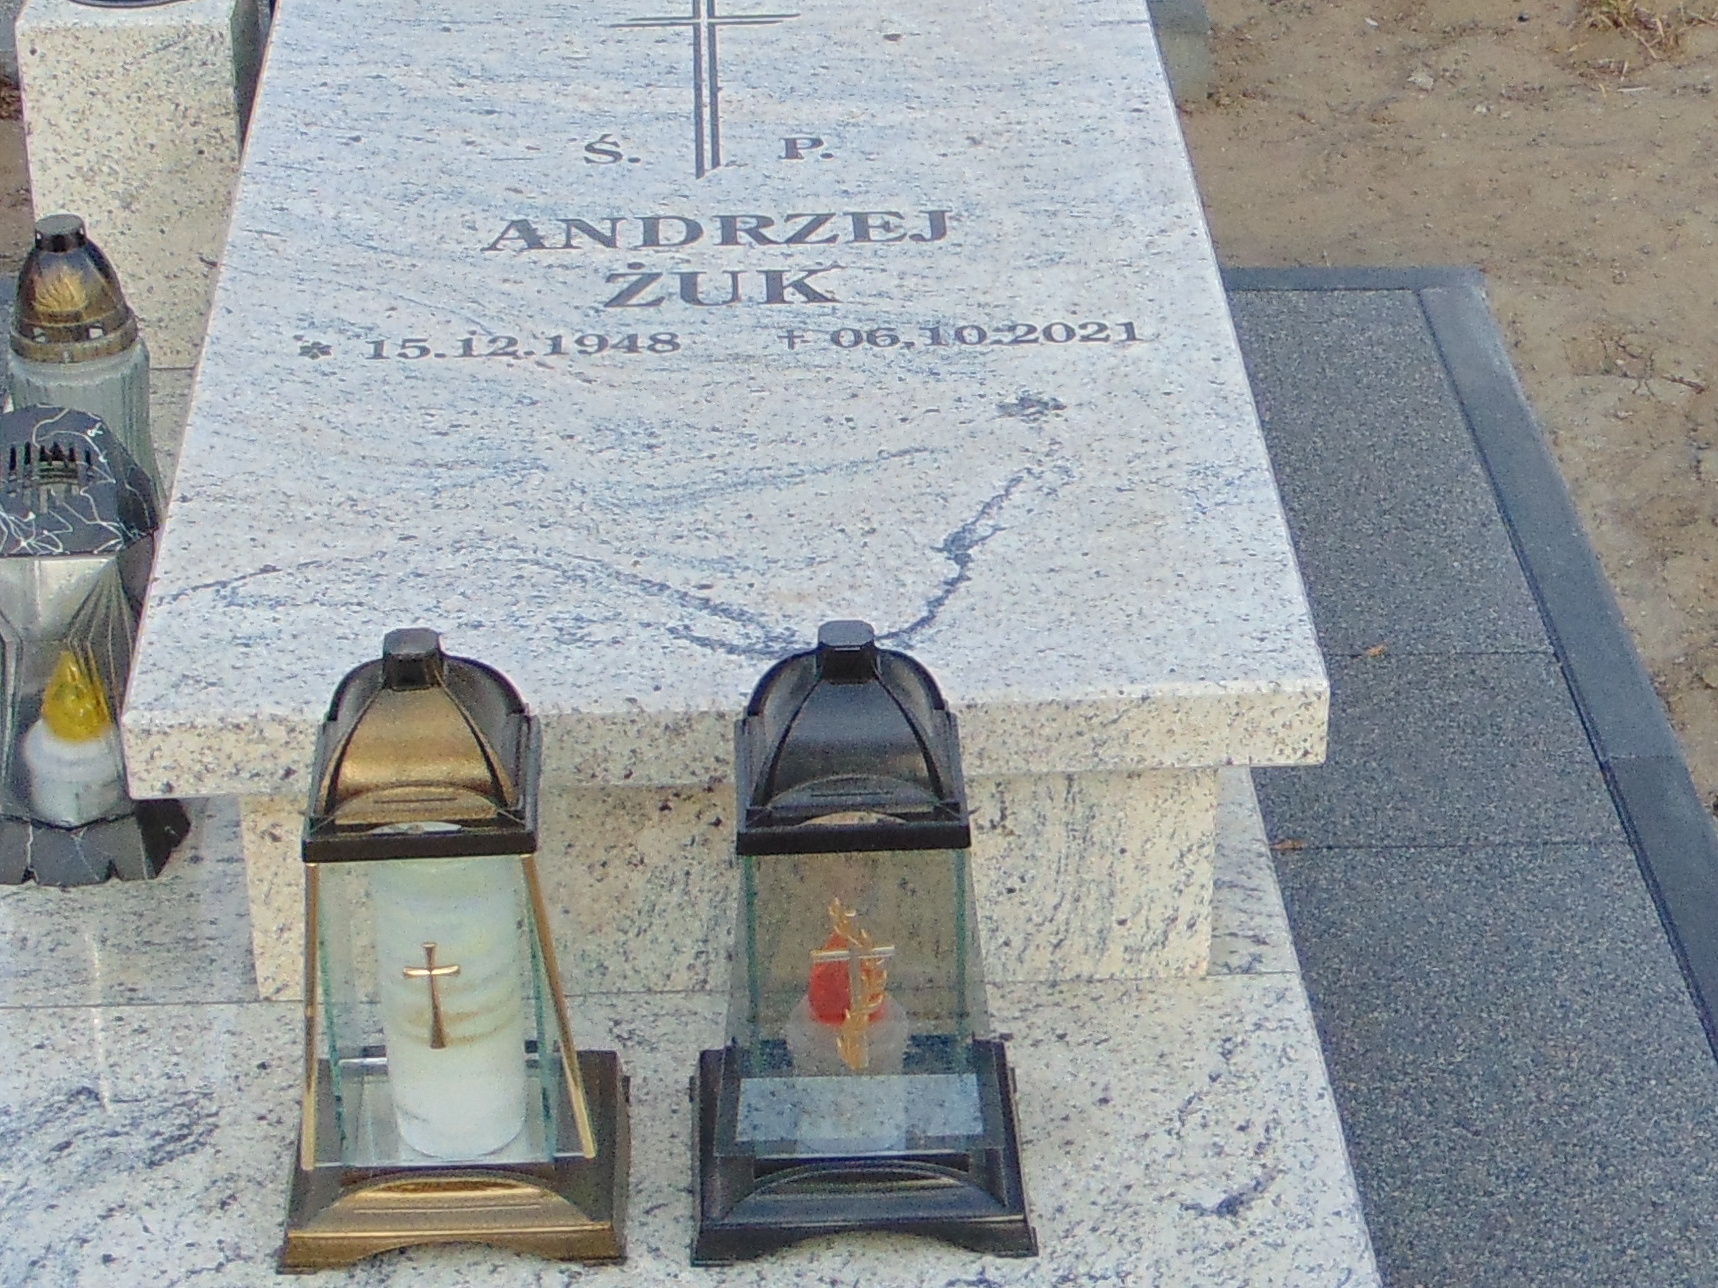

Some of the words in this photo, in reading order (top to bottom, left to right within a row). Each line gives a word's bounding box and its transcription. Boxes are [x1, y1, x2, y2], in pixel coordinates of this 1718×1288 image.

[779, 137, 836, 162] P.
[481, 209, 954, 253] ANDRZEJ
[603, 261, 843, 310] ŻUK
[364, 331, 682, 360] 15.12.1948
